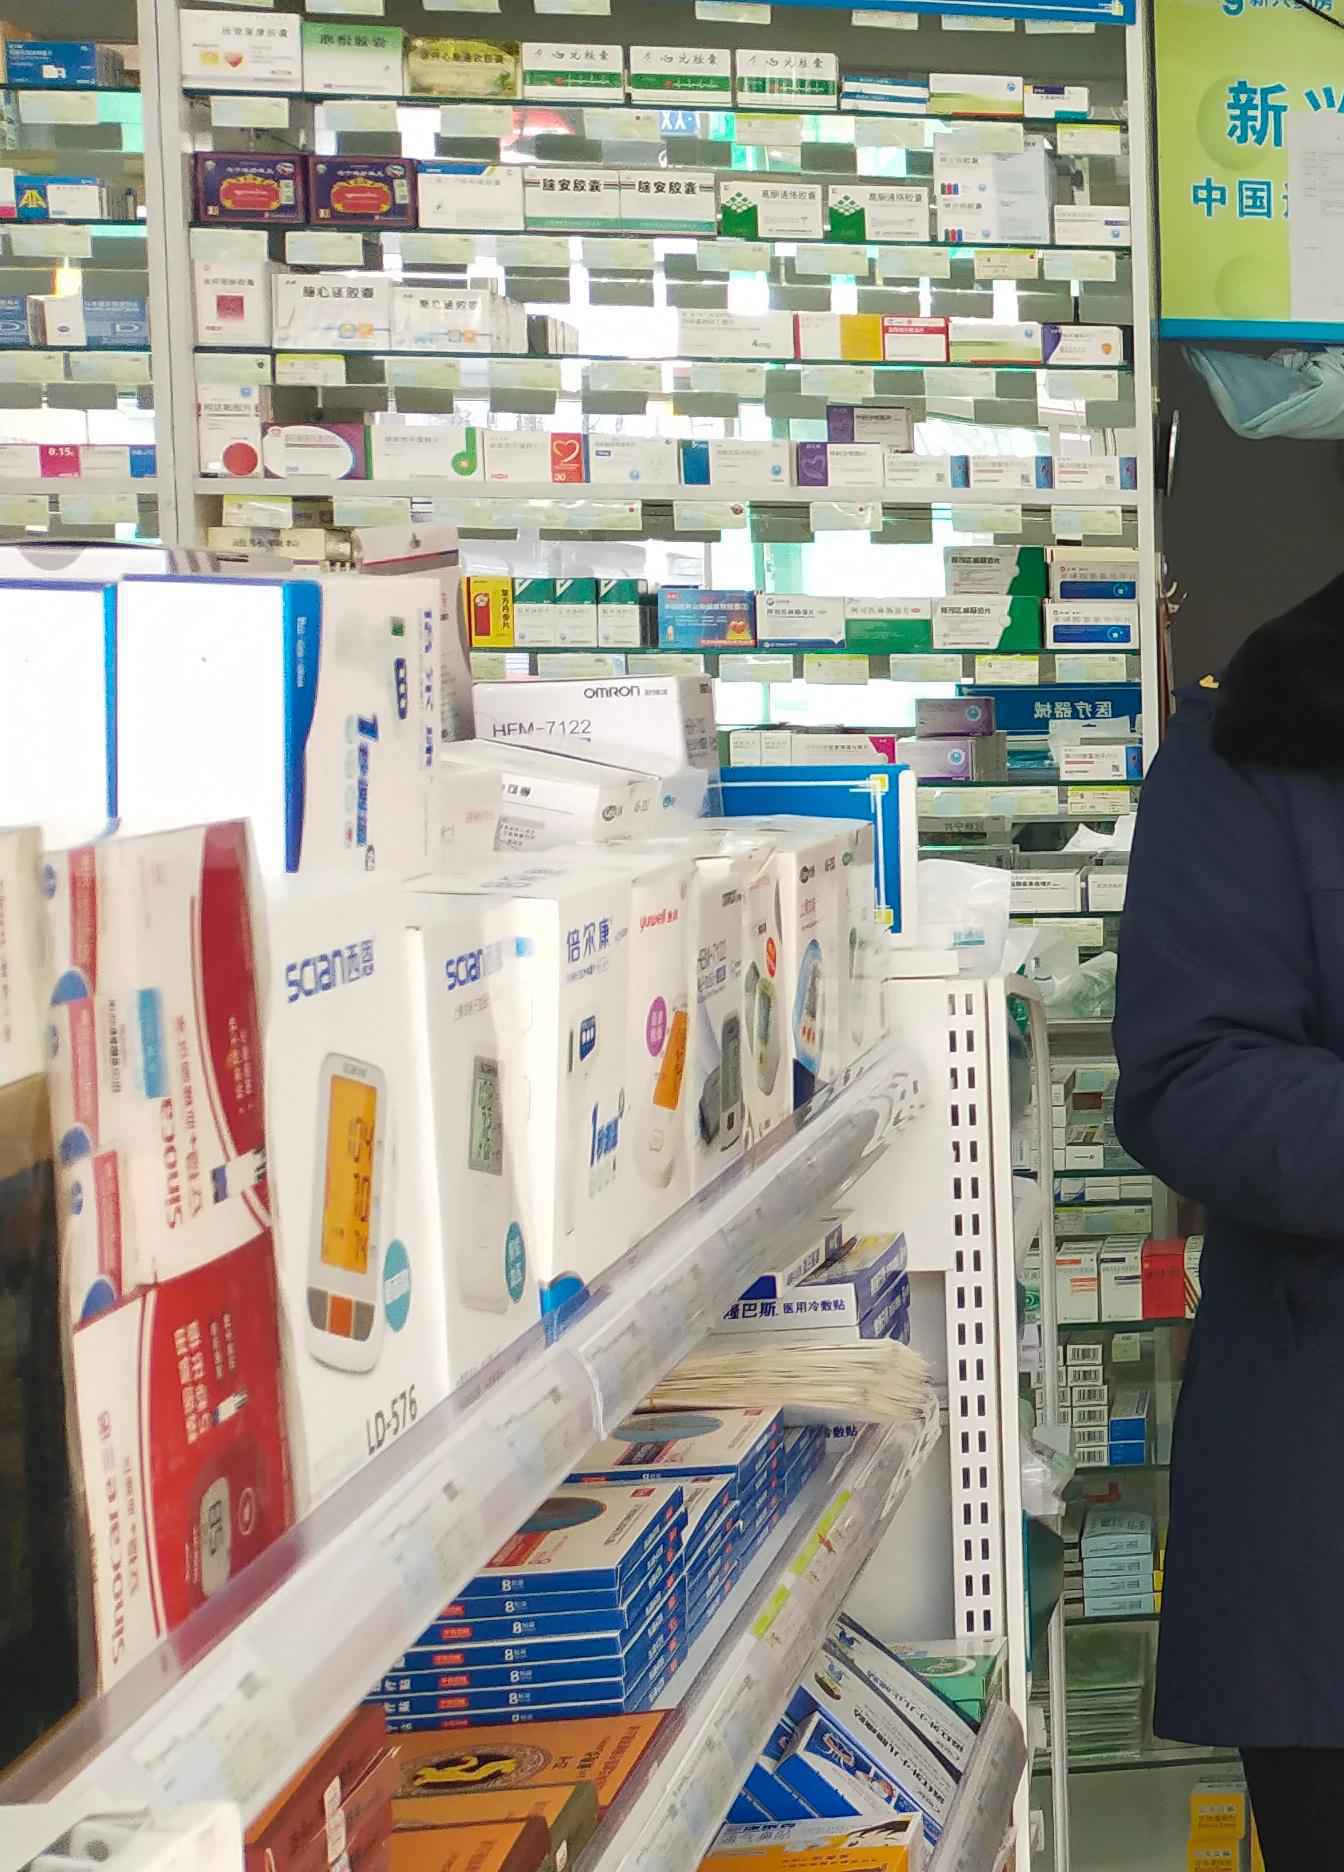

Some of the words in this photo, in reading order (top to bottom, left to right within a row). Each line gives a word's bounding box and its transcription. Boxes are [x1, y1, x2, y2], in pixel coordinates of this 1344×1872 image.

[492, 719, 592, 739] HEM-7122
[566, 917, 613, 964] 倍尔康
[365, 1382, 419, 1457] LD-576
